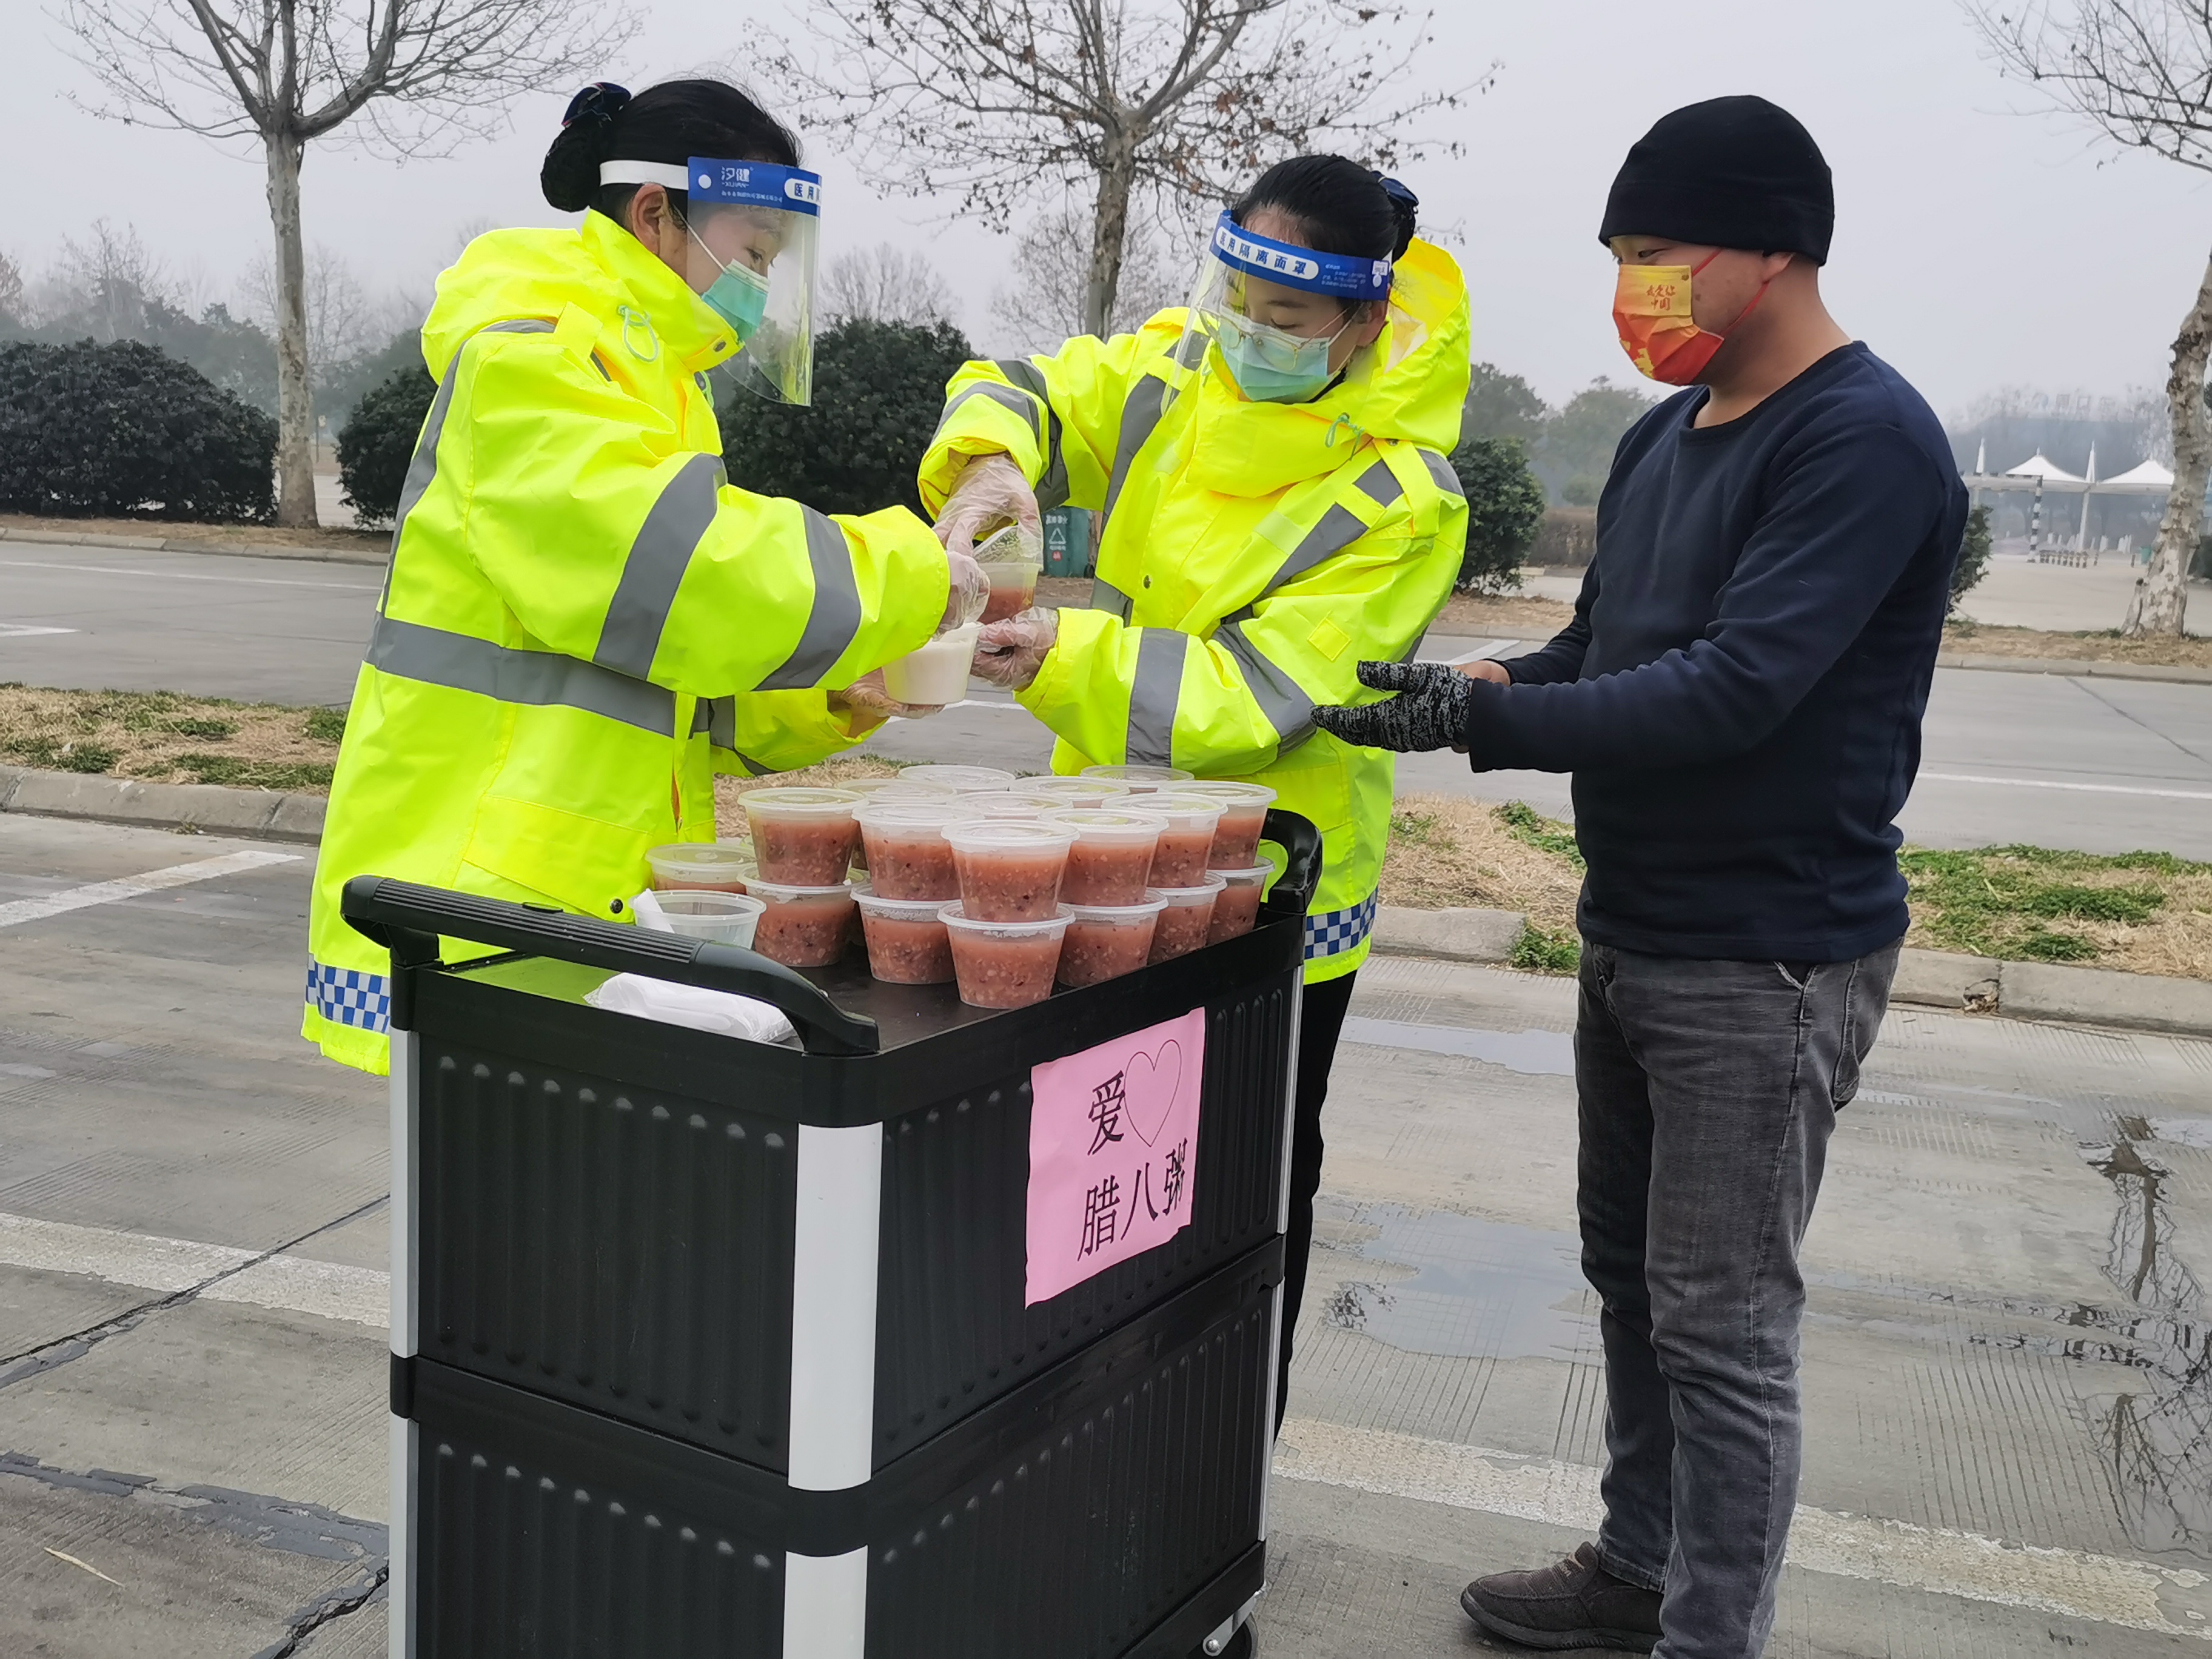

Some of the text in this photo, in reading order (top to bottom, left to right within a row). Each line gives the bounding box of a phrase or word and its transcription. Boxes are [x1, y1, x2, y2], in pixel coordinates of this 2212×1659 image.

[1219, 231, 1306, 275] 医用隔离面罩
[1087, 1070, 1125, 1156] 爱
[1077, 1138, 1188, 1262] 腊八粥
